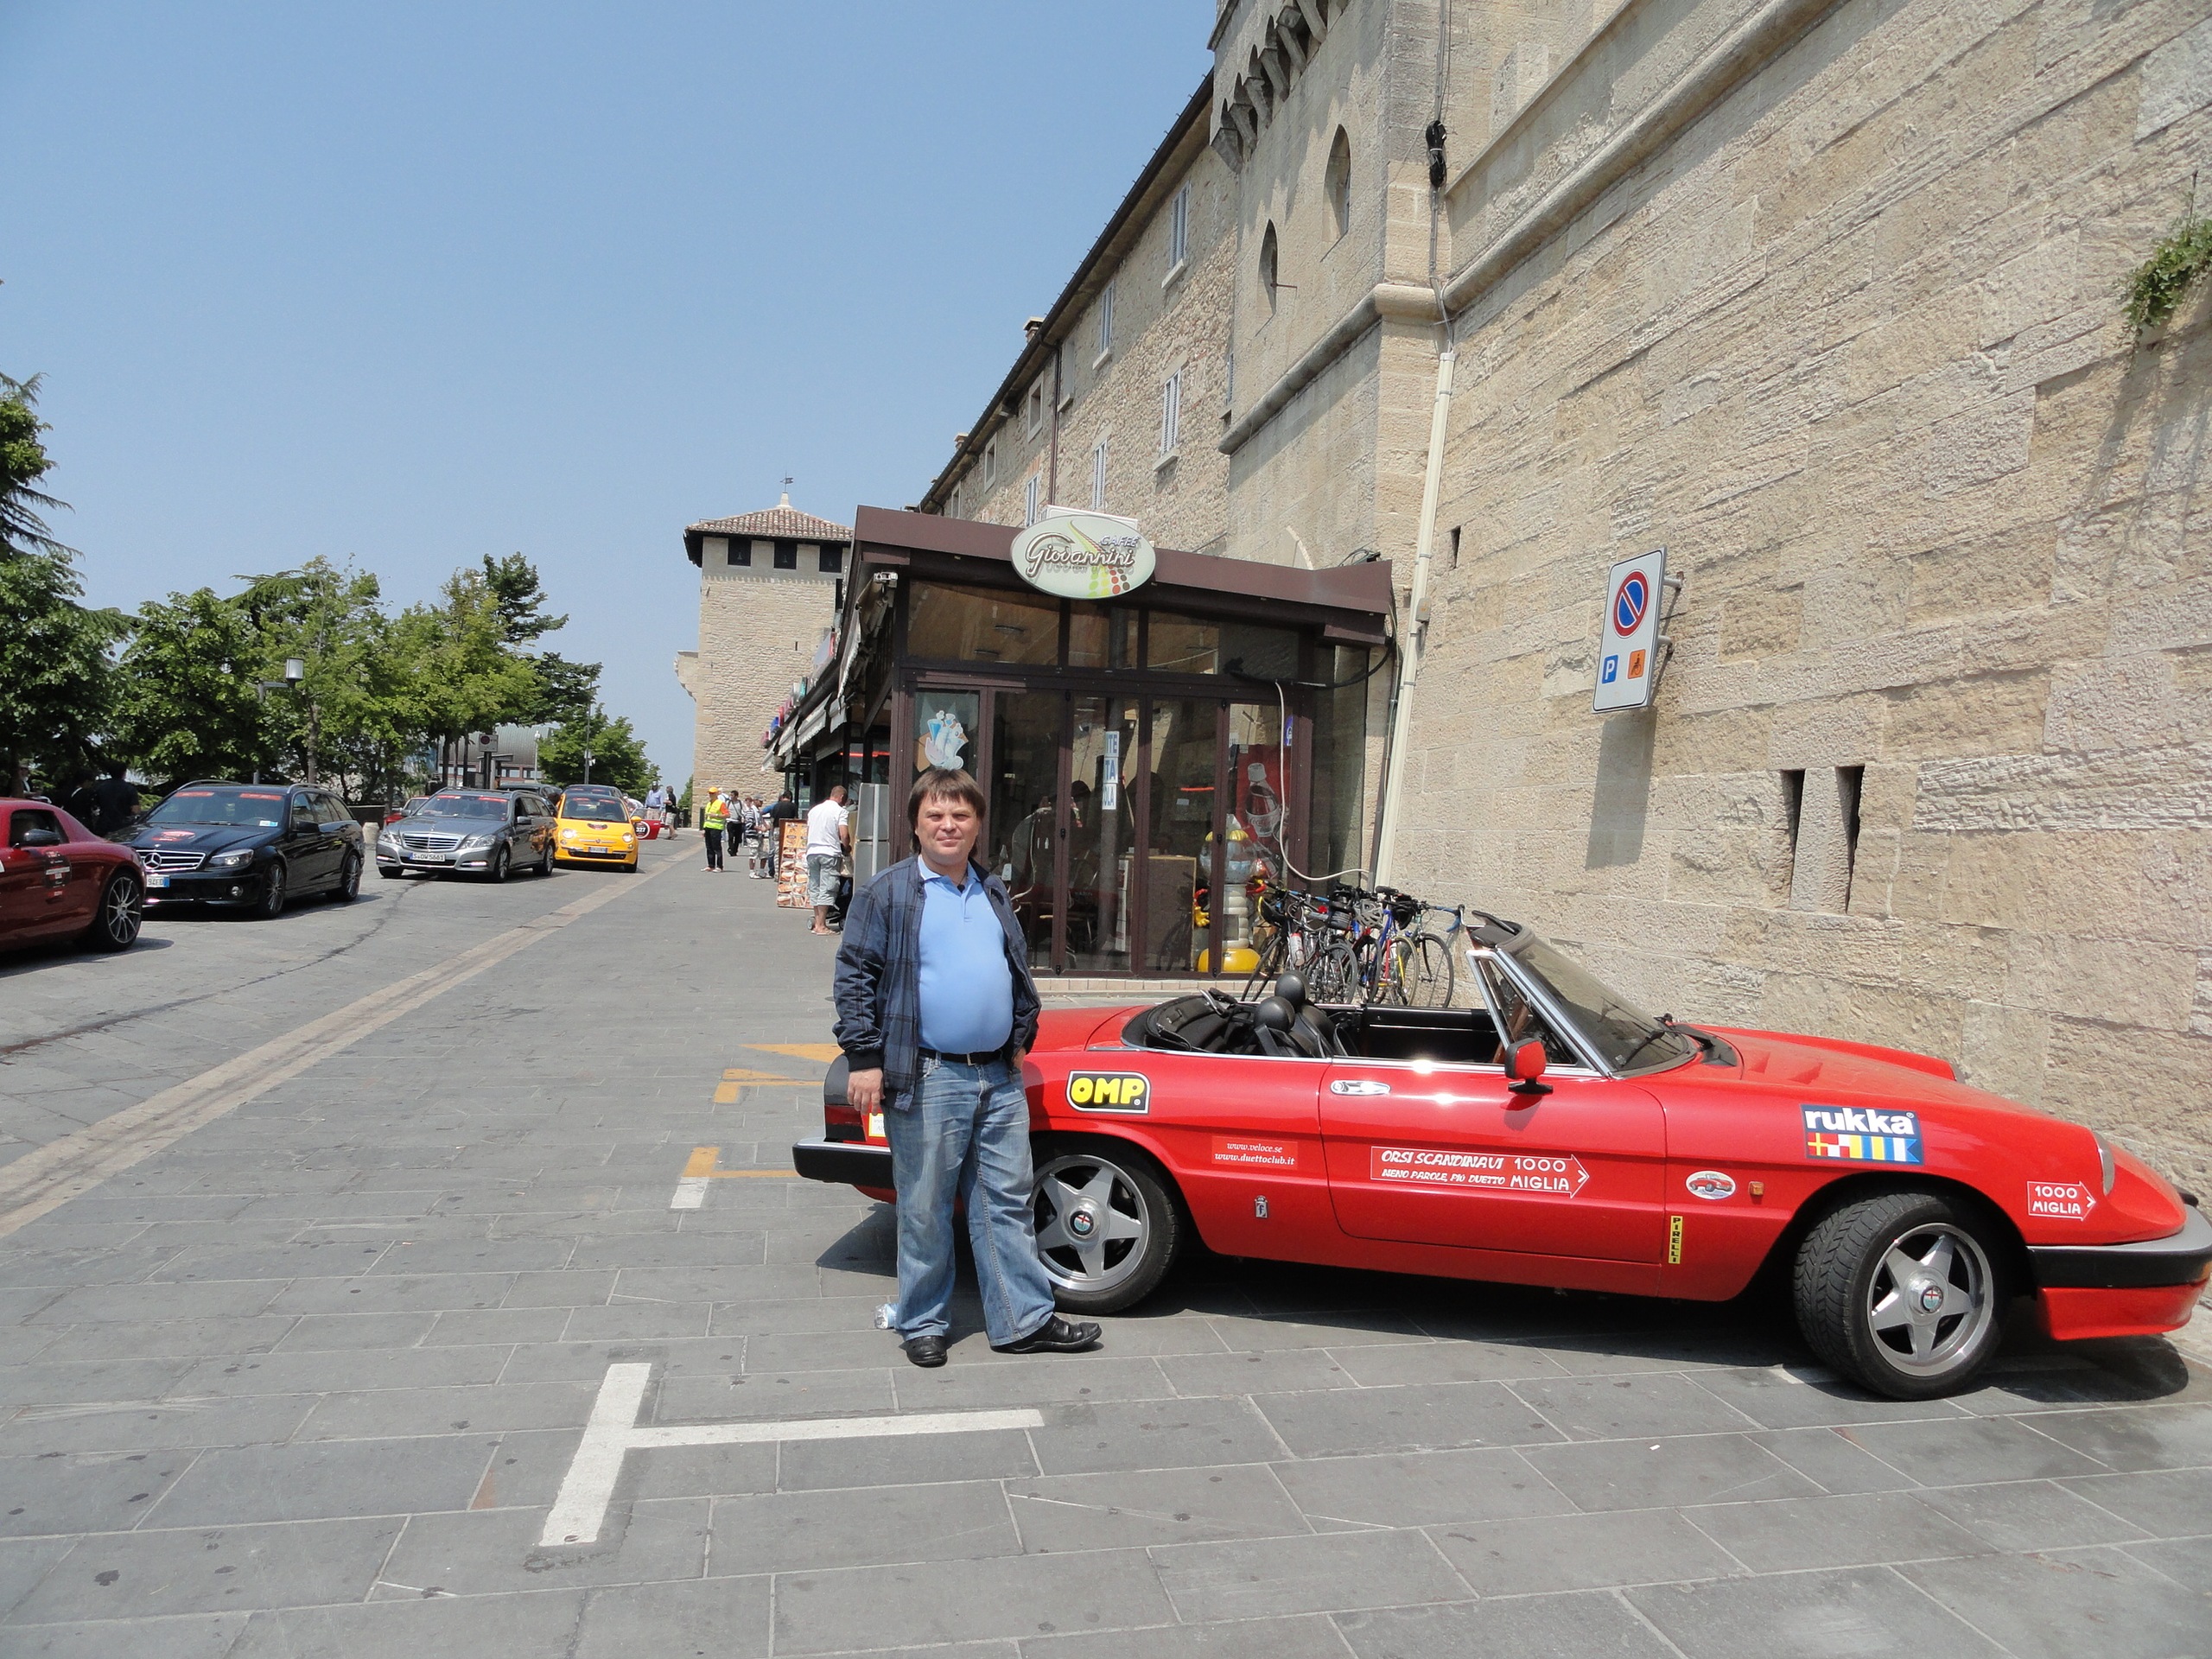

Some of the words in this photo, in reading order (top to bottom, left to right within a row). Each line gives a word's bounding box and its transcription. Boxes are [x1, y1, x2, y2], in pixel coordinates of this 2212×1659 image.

[1025, 532, 1135, 578] Giovannini
[1605, 660, 1615, 680] P
[1071, 1077, 1146, 1104] OMP
[1804, 1107, 1914, 1135] rukka
[1226, 1142, 1283, 1154] www.veloce.se
[1214, 1153, 1295, 1166] www.duettoclub.it
[1381, 1150, 1414, 1164] ORSI
[1414, 1152, 1504, 1169] SCANDINAVI
[1514, 1157, 1567, 1173] 1000
[1409, 1170, 1448, 1182] PAROLE,
[1468, 1174, 1506, 1185] DUETTO
[1510, 1174, 1569, 1191] MIGLIA
[2034, 1185, 2078, 1199] 1000
[2031, 1200, 2082, 1215] MIGLIA
[1671, 1217, 1681, 1262] PIRELLI
